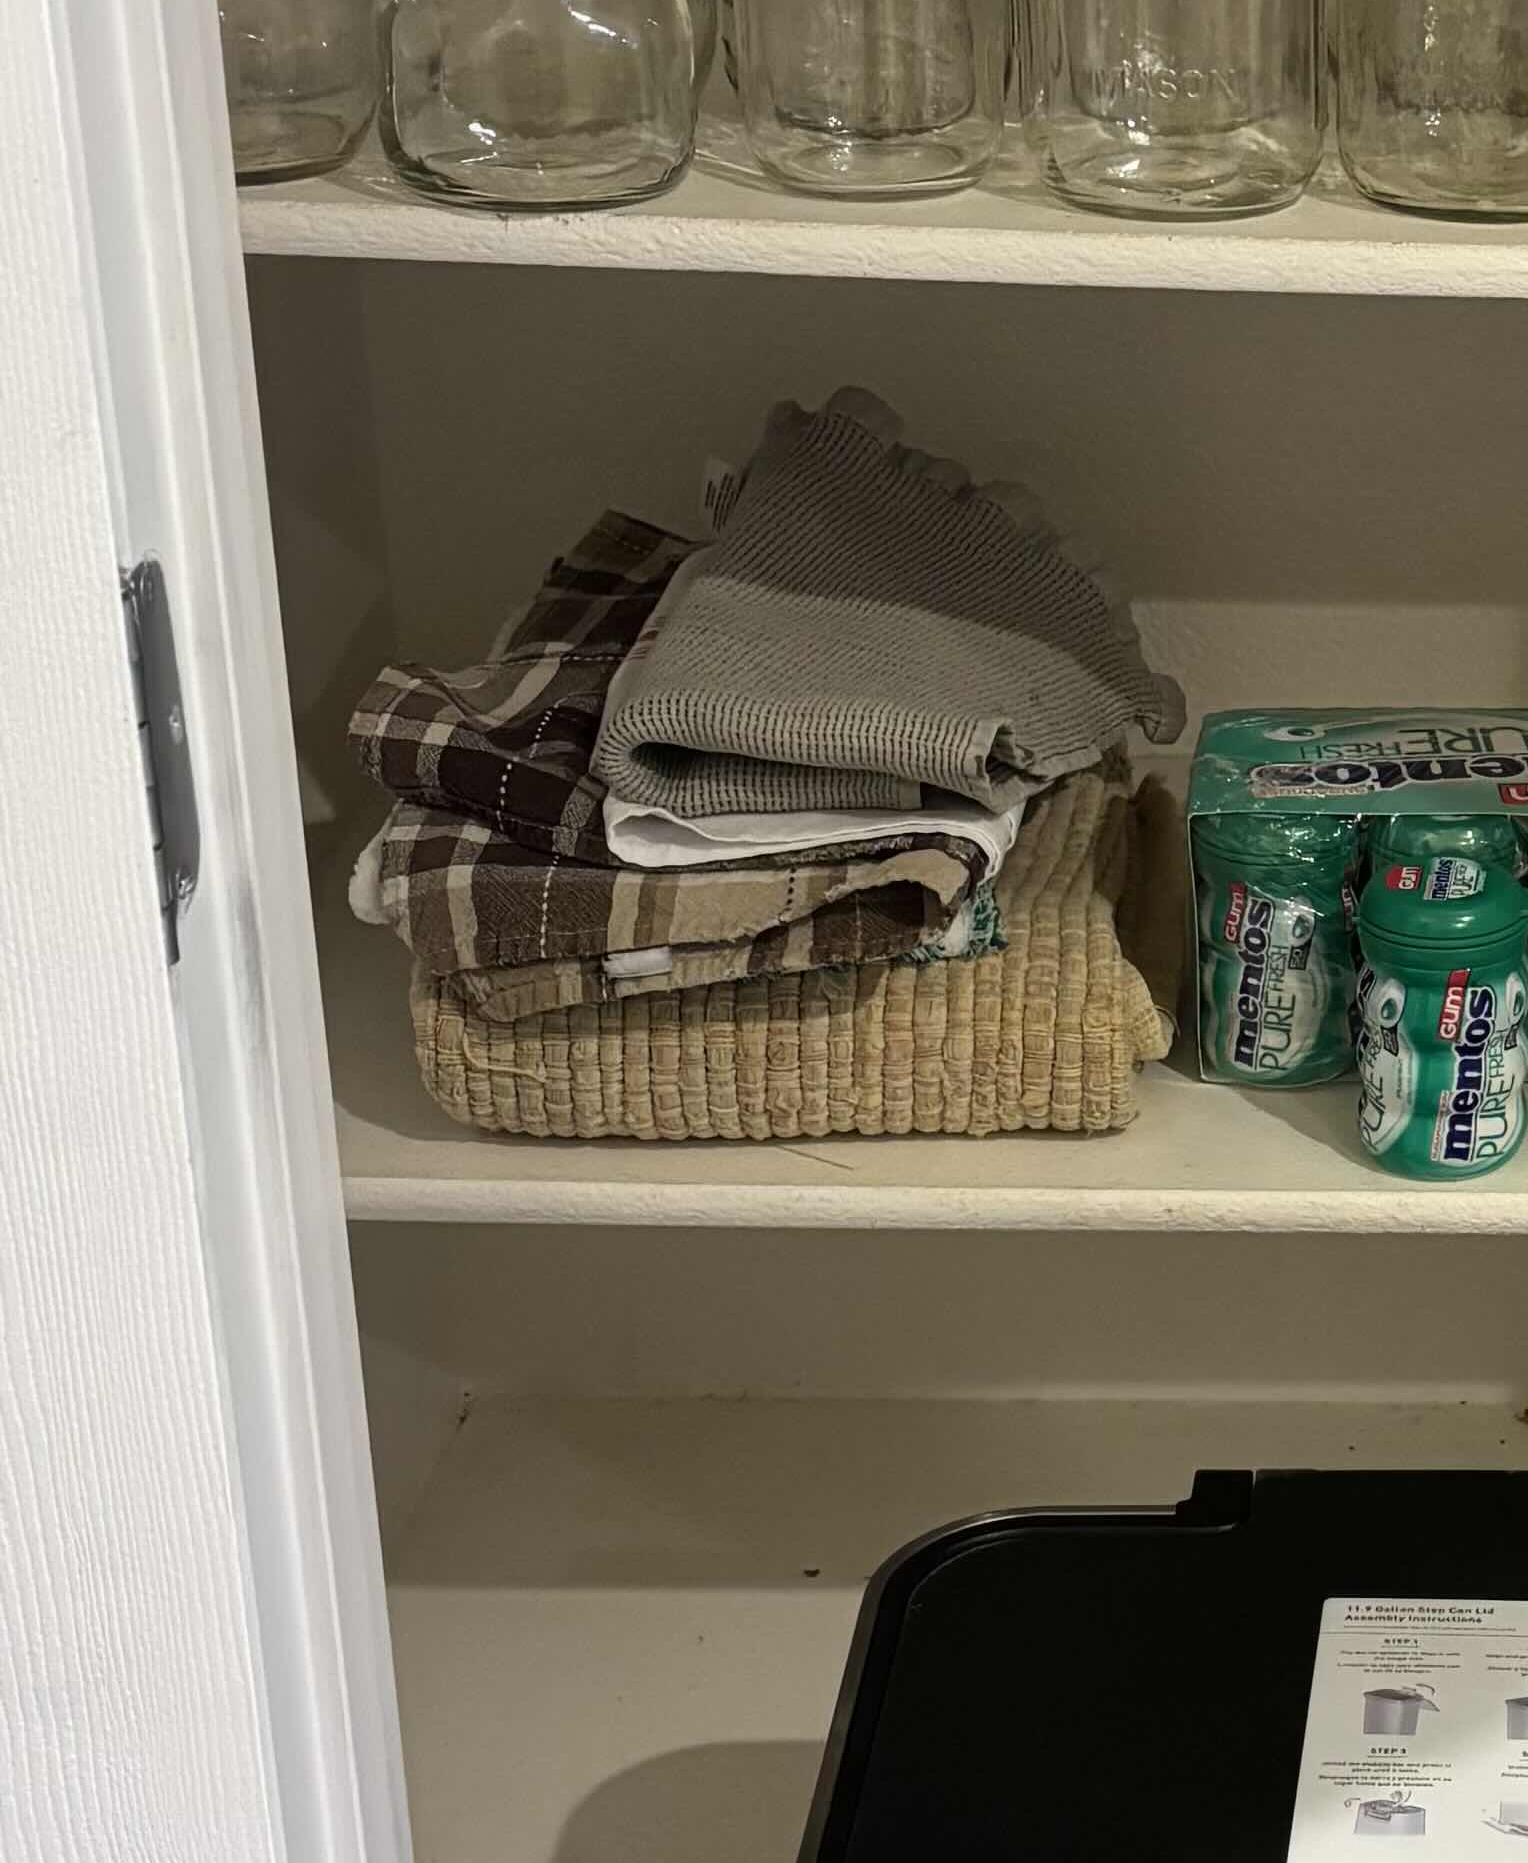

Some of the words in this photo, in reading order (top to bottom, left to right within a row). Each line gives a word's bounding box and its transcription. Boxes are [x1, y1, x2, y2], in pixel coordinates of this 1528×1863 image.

[1299, 742, 1400, 760] FRESH
[1430, 858, 1455, 900] mentos
[1234, 899, 1273, 1067] mentos
[1265, 944, 1289, 993] FRESH
[1259, 991, 1297, 1071] PURE
[1487, 1028, 1510, 1079] FRESH
[1442, 987, 1493, 1163] mentos
[1475, 1074, 1515, 1160] PURE
